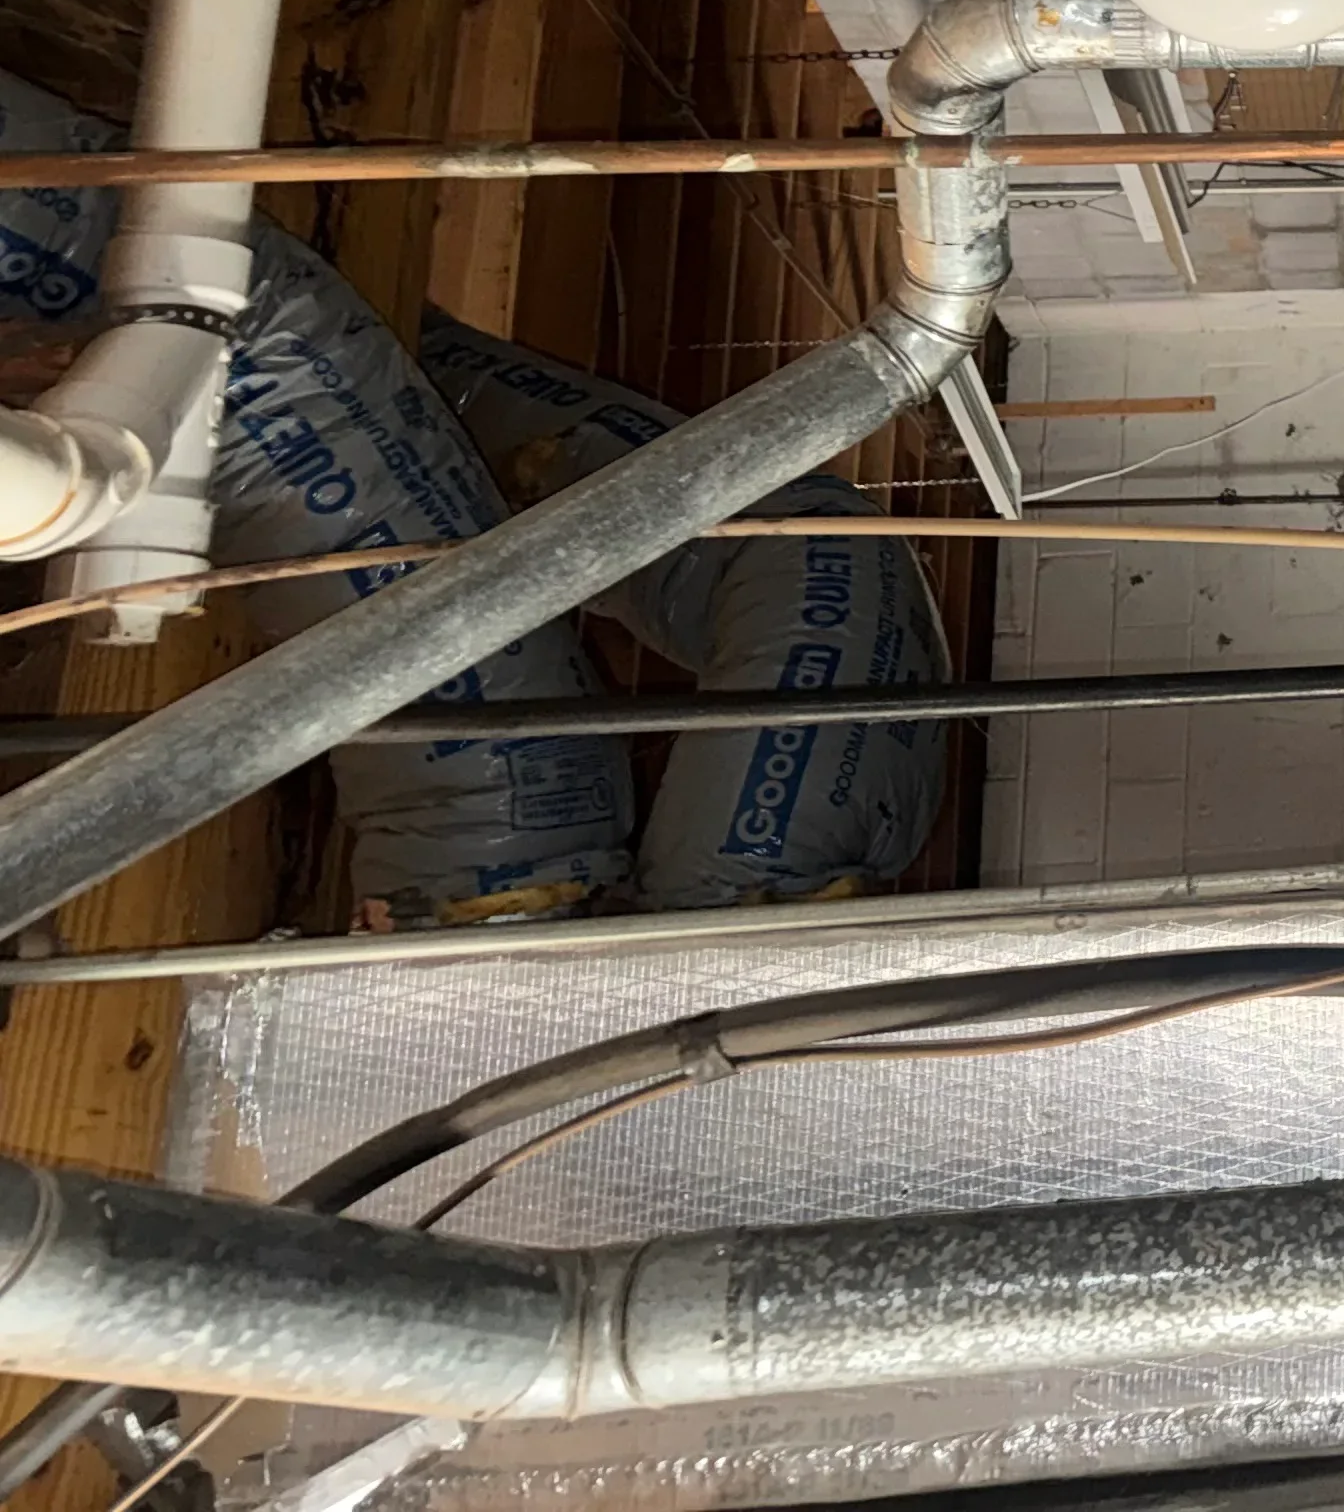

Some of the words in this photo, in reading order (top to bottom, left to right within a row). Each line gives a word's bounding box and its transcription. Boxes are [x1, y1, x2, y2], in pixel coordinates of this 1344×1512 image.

[238, 404, 356, 514] QUIET
[736, 650, 831, 845] Goodan
[802, 548, 853, 628] QUIET
[829, 723, 869, 807] GOODMA
